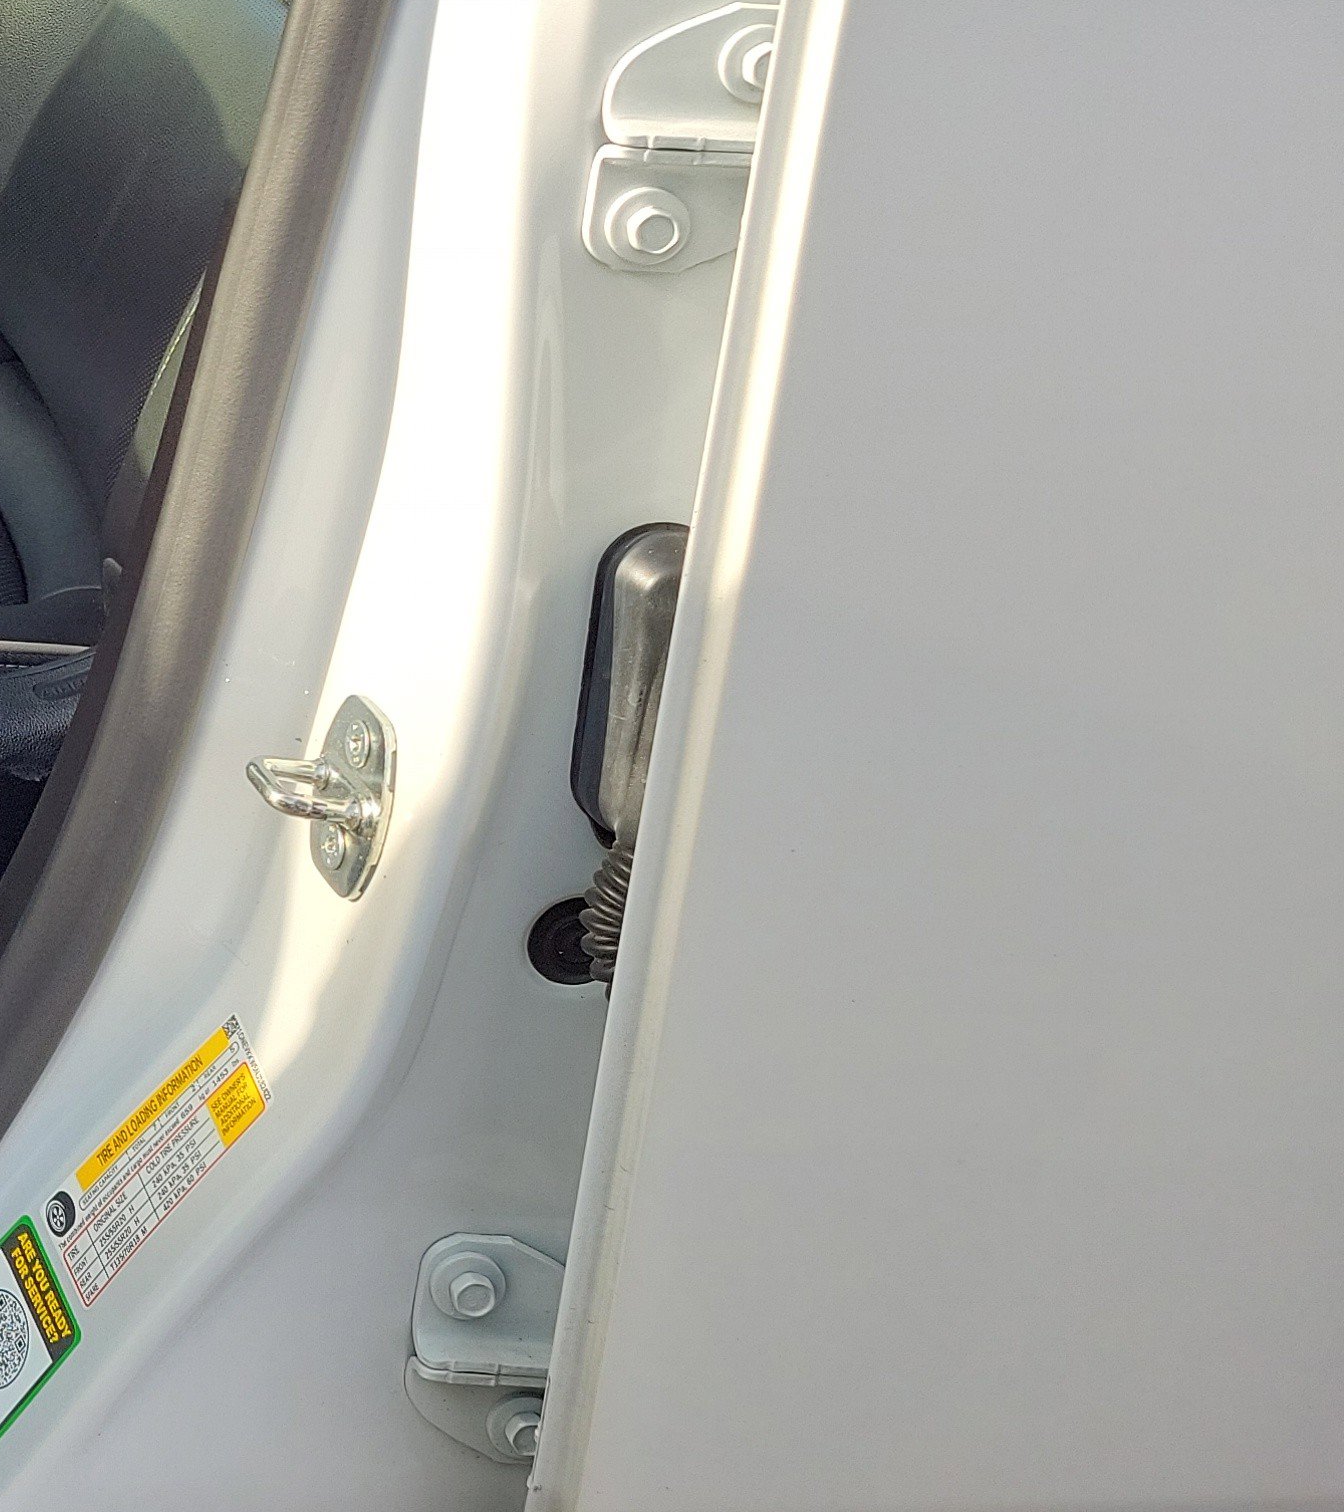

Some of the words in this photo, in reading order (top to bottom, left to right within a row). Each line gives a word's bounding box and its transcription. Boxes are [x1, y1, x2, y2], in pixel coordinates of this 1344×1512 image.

[203, 1065, 215, 1079] REAR
[211, 1097, 221, 1111] SEE
[221, 1072, 245, 1100] OWNER'S
[215, 1093, 235, 1118] MANUAL
[236, 1081, 247, 1096] FOR
[96, 1144, 113, 1166] TIRE
[112, 1128, 129, 1151] AND
[126, 1099, 157, 1136] LOADING
[156, 1057, 202, 1106] INFORMATION
[165, 1101, 179, 1118] FRONT
[220, 1091, 249, 1125] ADDITIONAL
[221, 1096, 255, 1136] INFORMATION
[65, 1219, 85, 1242] combined
[84, 1204, 98, 1222] weight
[102, 1178, 122, 1203] occupants
[122, 1169, 130, 1180] and
[130, 1157, 142, 1172] cargo
[142, 1146, 152, 1159] must
[153, 1134, 164, 1148] never
[164, 1118, 179, 1135] exceed
[180, 1103, 192, 1119] 659
[212, 1067, 228, 1086] 1453
[99, 1165, 118, 1187] CAPACITY
[132, 1137, 145, 1152] TOTAL
[67, 1244, 79, 1261] TIRE
[92, 1203, 116, 1232] ORIGINAL
[114, 1191, 127, 1207] SIZE
[145, 1155, 160, 1174] COLD
[160, 1143, 172, 1158] TIRE
[171, 1115, 198, 1147] PRESSURE
[73, 1256, 88, 1276] FRONT
[98, 1213, 126, 1247] 255/55R20
[152, 1173, 163, 1188] 240
[176, 1150, 184, 1162] 35
[185, 1138, 196, 1152] PSI
[79, 1272, 91, 1288] REAR
[104, 1226, 132, 1259] 255/55R20
[157, 1185, 168, 1200] 240
[181, 1163, 189, 1174] 35
[190, 1150, 201, 1164] PSI
[85, 1282, 99, 1301] SPARE
[162, 1197, 173, 1212] 420
[187, 1174, 194, 1185] 60
[195, 1161, 206, 1176] PSI
[11, 1247, 31, 1279] FOR
[25, 1277, 60, 1344] SERVICE?
[17, 1233, 37, 1263] ARE
[31, 1259, 50, 1290] YOU
[44, 1285, 72, 1338] READY
